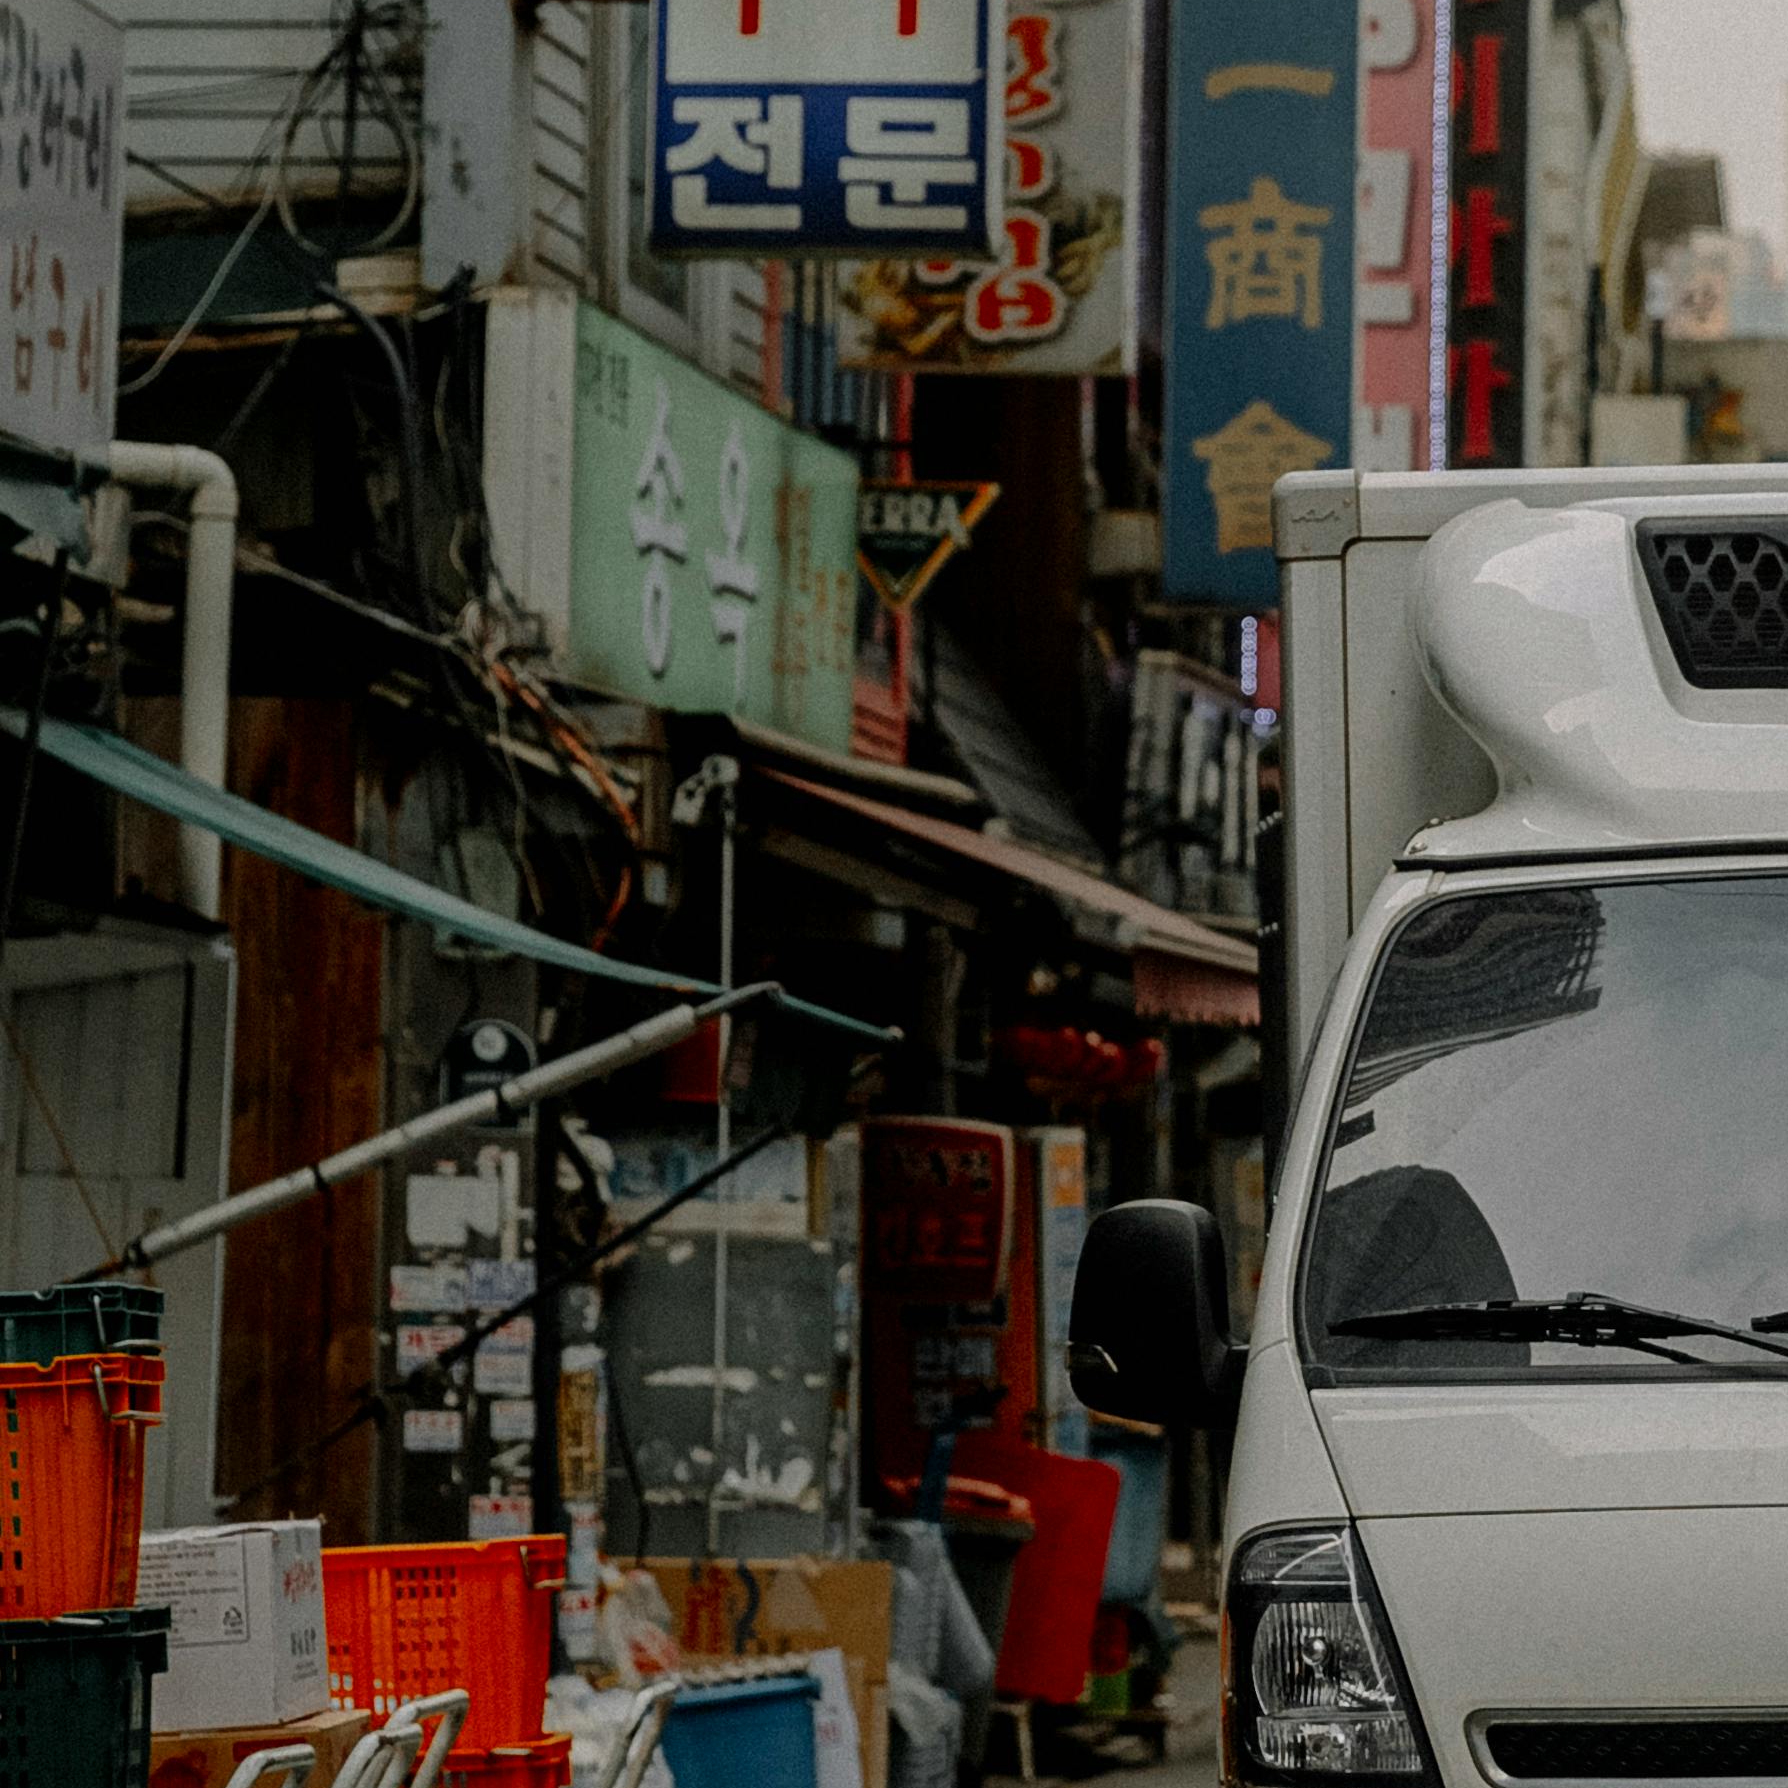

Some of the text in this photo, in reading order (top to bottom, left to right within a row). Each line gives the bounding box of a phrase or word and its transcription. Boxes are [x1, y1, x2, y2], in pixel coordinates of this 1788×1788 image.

[665, 91, 978, 231] 전문
[629, 372, 761, 711] 송옥
[860, 491, 972, 549] ERRA
